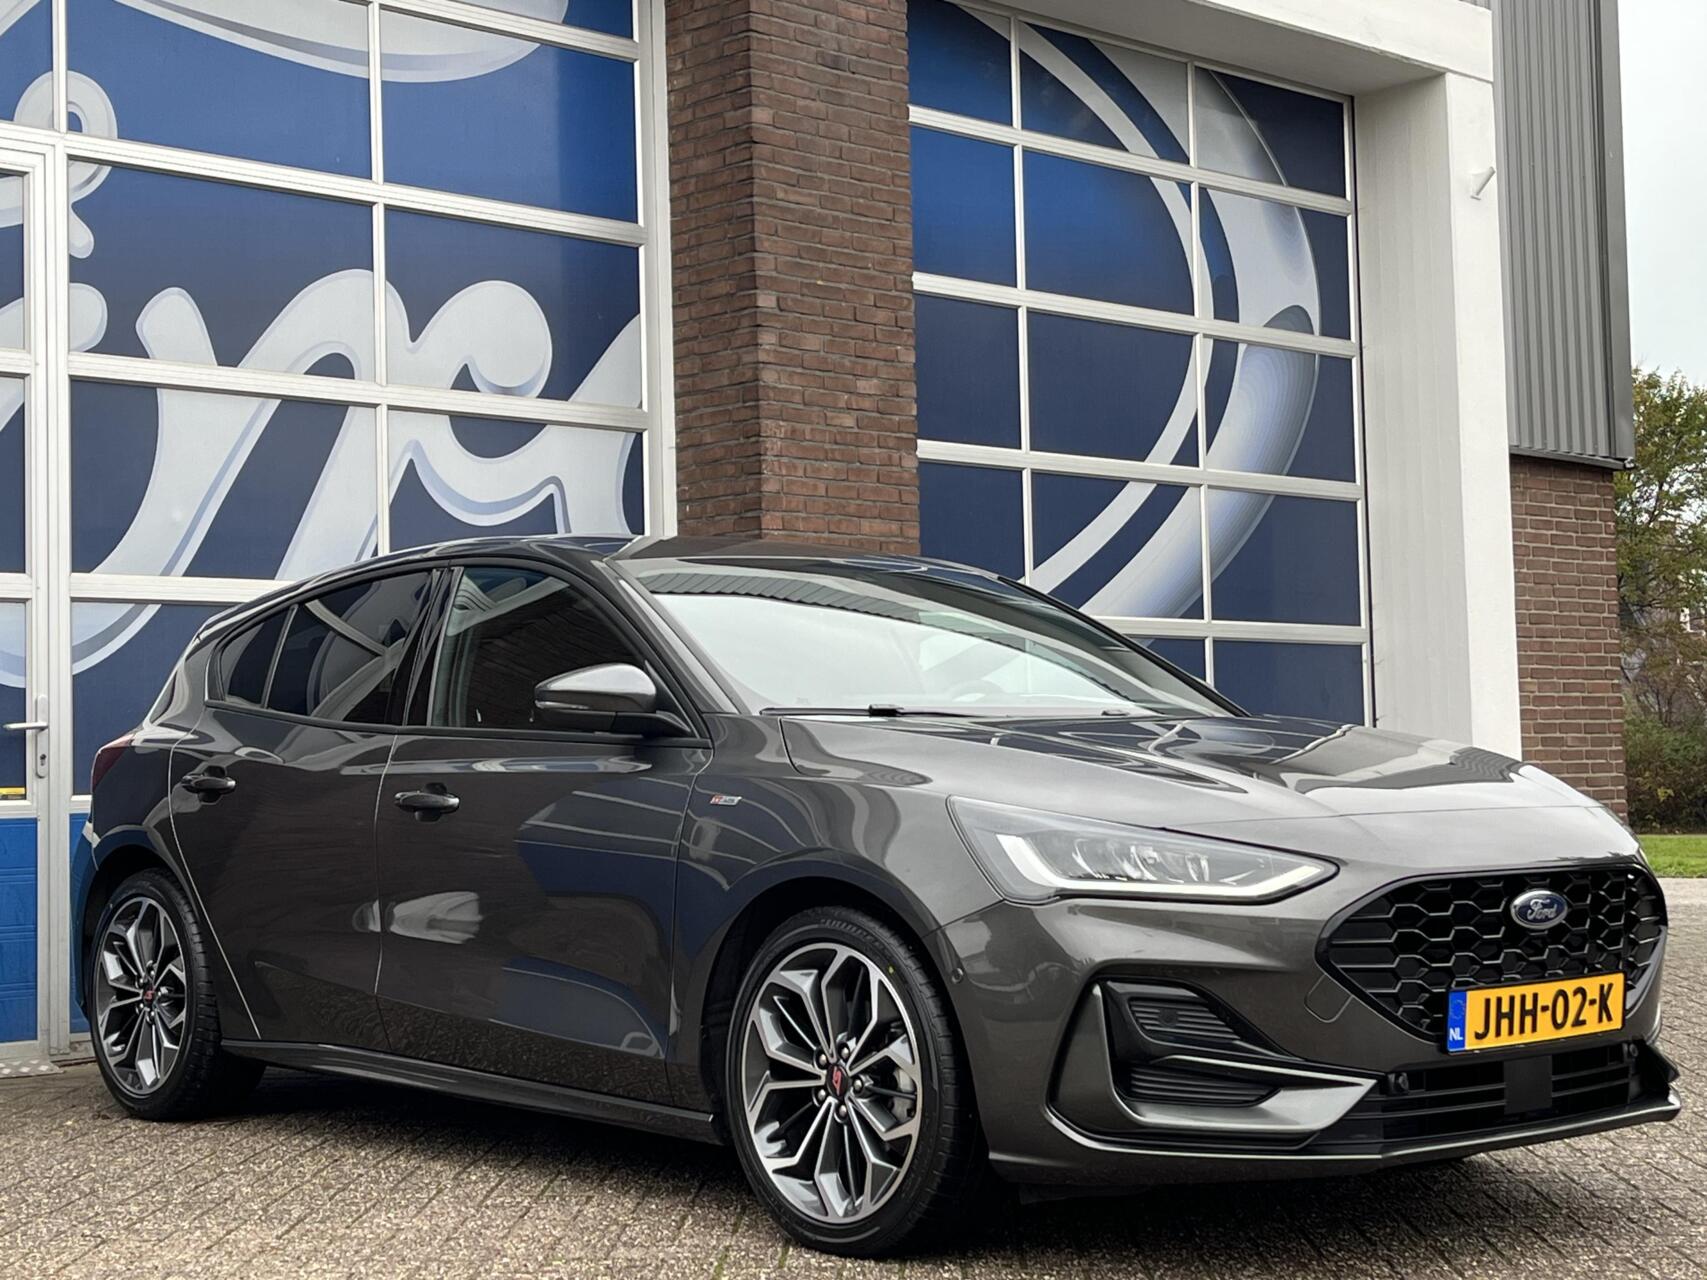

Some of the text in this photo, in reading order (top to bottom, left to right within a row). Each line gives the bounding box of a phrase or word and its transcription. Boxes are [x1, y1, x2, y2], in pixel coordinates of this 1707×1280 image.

[1527, 899, 1557, 920] Ford
[1474, 983, 1614, 1040] JHH-02-K
[1449, 1027, 1464, 1041] NL
